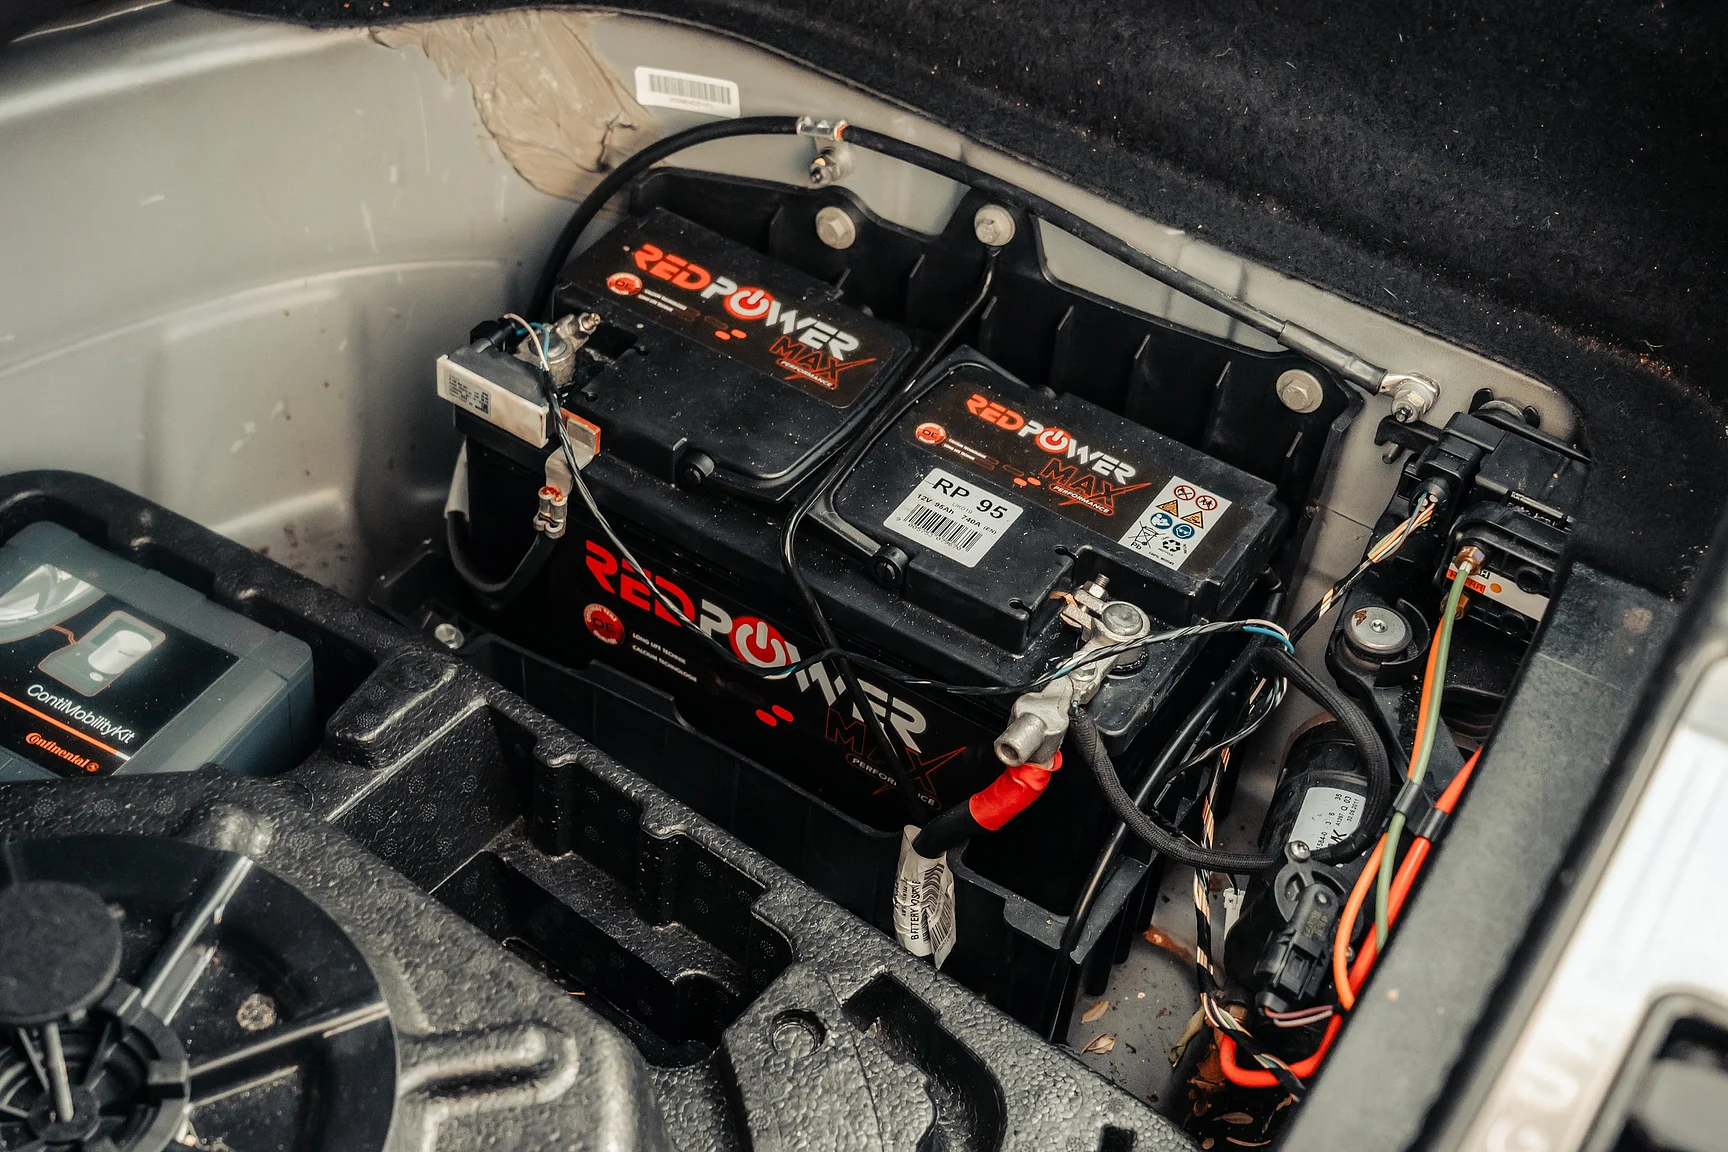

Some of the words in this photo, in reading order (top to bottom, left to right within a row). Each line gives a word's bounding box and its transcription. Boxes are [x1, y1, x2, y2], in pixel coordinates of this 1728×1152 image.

[770, 334, 877, 382] MAX
[780, 360, 833, 387] PERFORMANCE
[932, 477, 970, 499] RP
[976, 499, 1008, 520] 95
[1041, 458, 1151, 506] MAX
[917, 493, 933, 504] 12V
[934, 501, 955, 516] 95Ah
[961, 514, 981, 528] 740A
[1053, 484, 1111, 515] PERFORMANCE
[1130, 541, 1142, 550] Pb
[593, 616, 616, 633] OE
[27, 684, 136, 745] ContiMobilityKit
[25, 732, 89, 768] Continental
[1335, 793, 1342, 801] 35
[1343, 795, 1351, 804] 03
